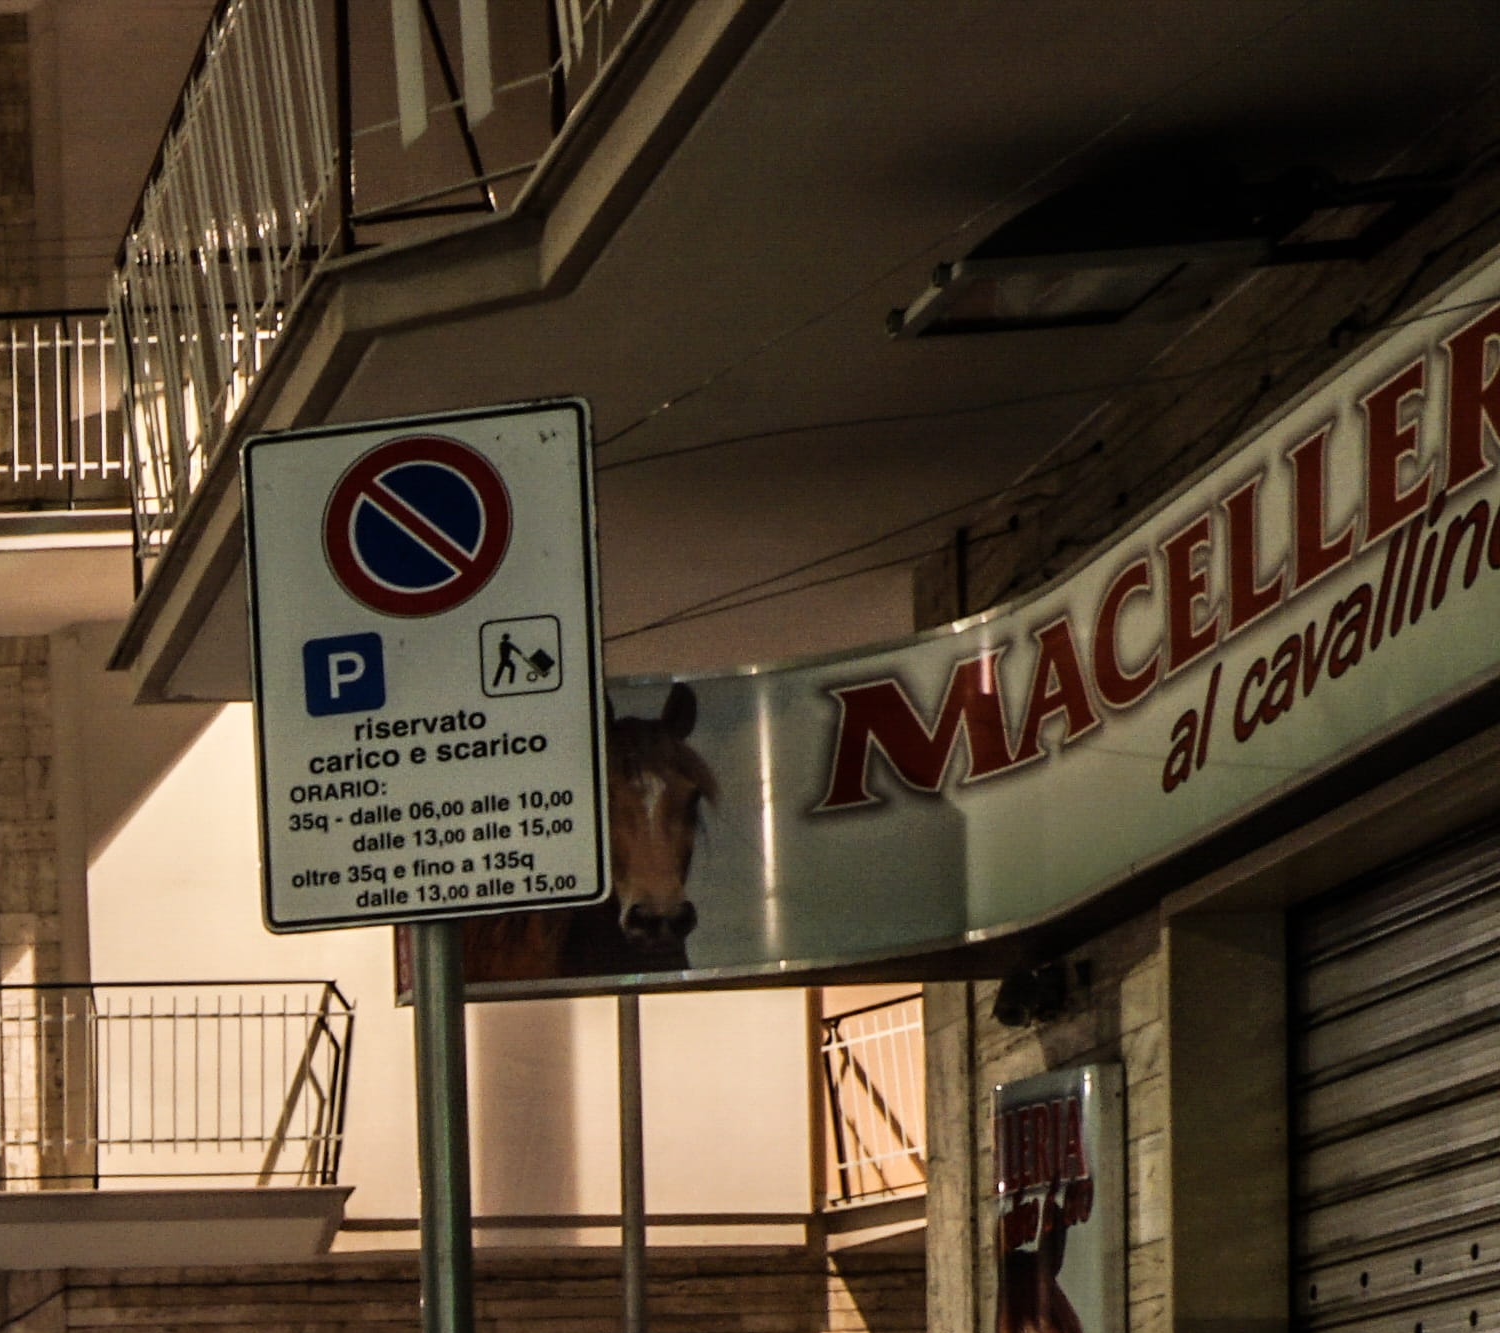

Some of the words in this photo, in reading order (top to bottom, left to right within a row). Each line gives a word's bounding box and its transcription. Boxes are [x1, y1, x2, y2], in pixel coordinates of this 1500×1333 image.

[327, 650, 366, 699] P
[354, 709, 487, 741] riservato
[1162, 662, 1223, 793] al
[309, 747, 400, 775] carico
[410, 746, 427, 764] e
[436, 733, 548, 762] scarico
[290, 779, 388, 804] ORARIO:
[289, 812, 329, 833] 35q
[350, 804, 401, 826] dalle
[409, 801, 464, 821] 06,00
[471, 795, 510, 814] alle
[518, 790, 574, 810] 10,00
[352, 832, 405, 852] dalle
[413, 828, 466, 848] 13,00
[472, 823, 511, 842] alle
[519, 818, 574, 838] 15,00
[291, 868, 341, 889] oltre
[348, 865, 387, 884] 35q
[394, 865, 406, 879] e
[413, 858, 455, 878] fino
[461, 858, 475, 873] a
[482, 851, 534, 871] 135q
[356, 888, 409, 908] dalle
[416, 884, 469, 904] 13,00
[476, 879, 515, 898] alle
[523, 874, 577, 894] 15,00
